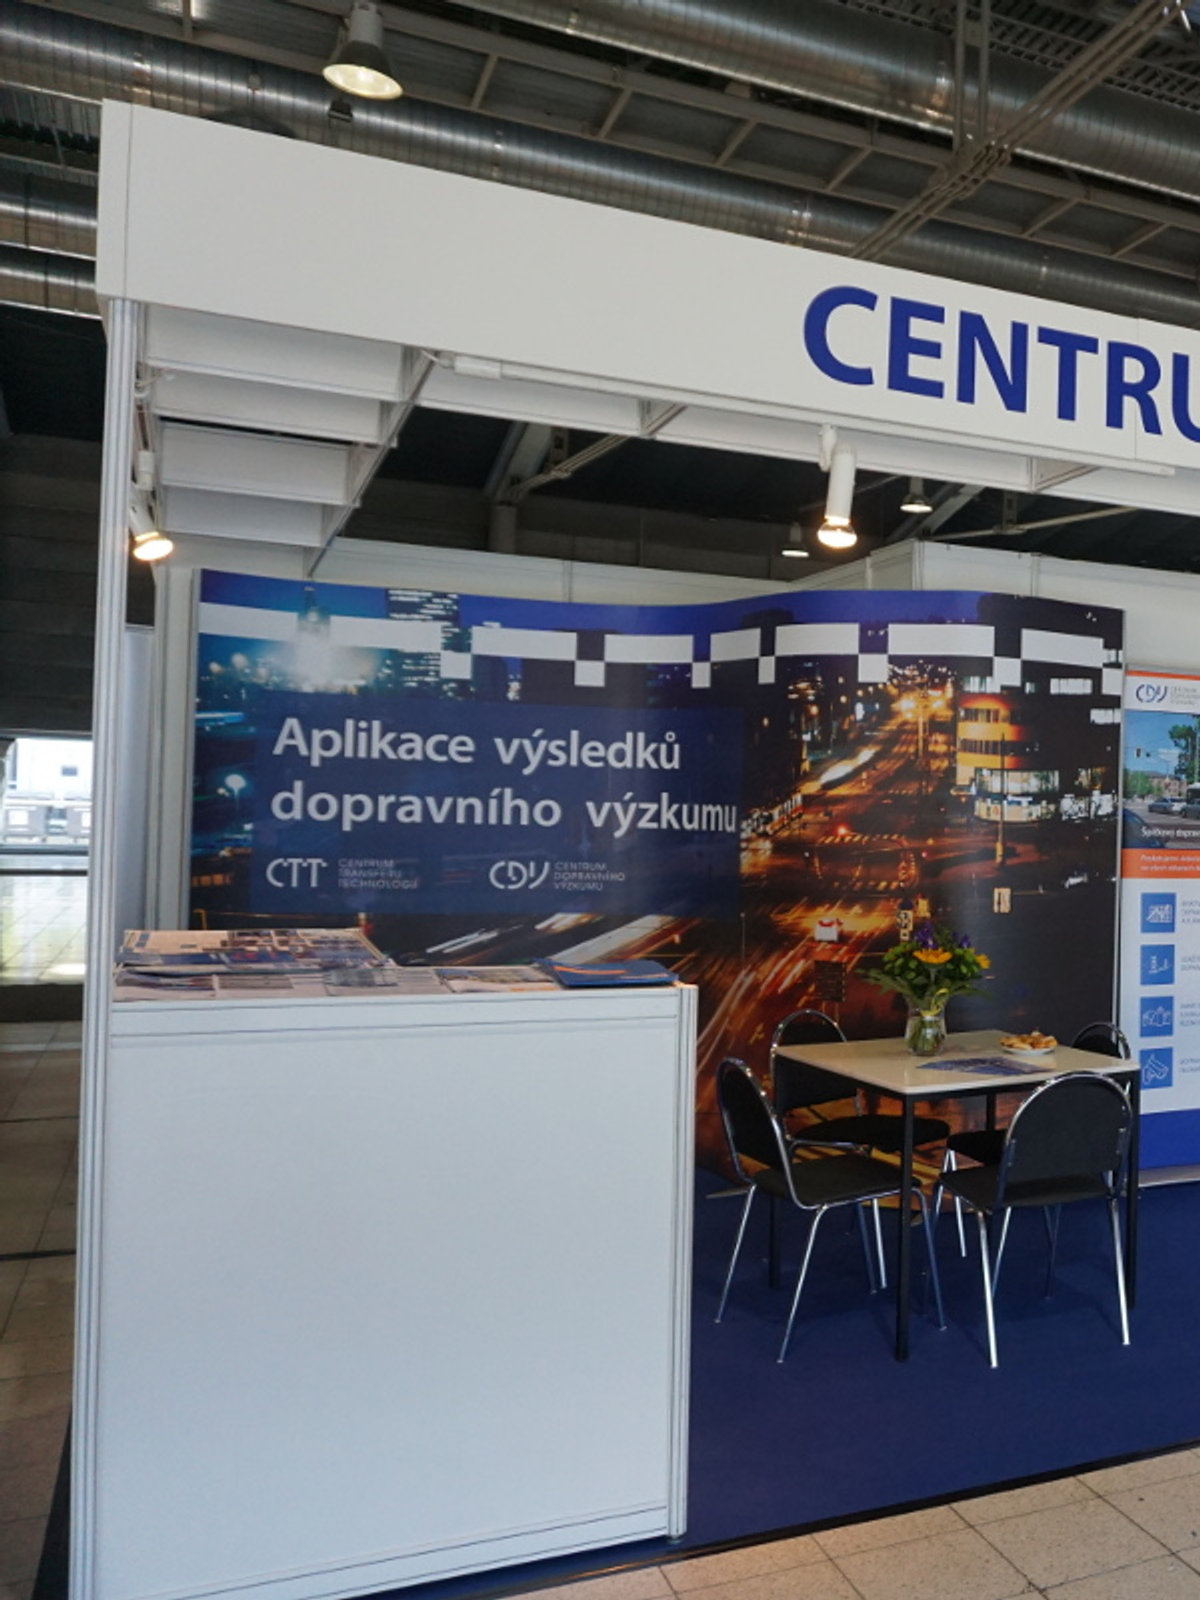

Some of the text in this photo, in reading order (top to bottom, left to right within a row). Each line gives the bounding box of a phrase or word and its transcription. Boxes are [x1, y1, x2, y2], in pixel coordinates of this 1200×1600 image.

[272, 717, 681, 775] Aplikace výsledků
[270, 780, 737, 838] dopravního výzkumu
[265, 858, 328, 888] CTT
[338, 858, 395, 868] CENTRUM
[554, 862, 607, 871] CENTRUM
[554, 871, 625, 882] DOPRAVNÍHO
